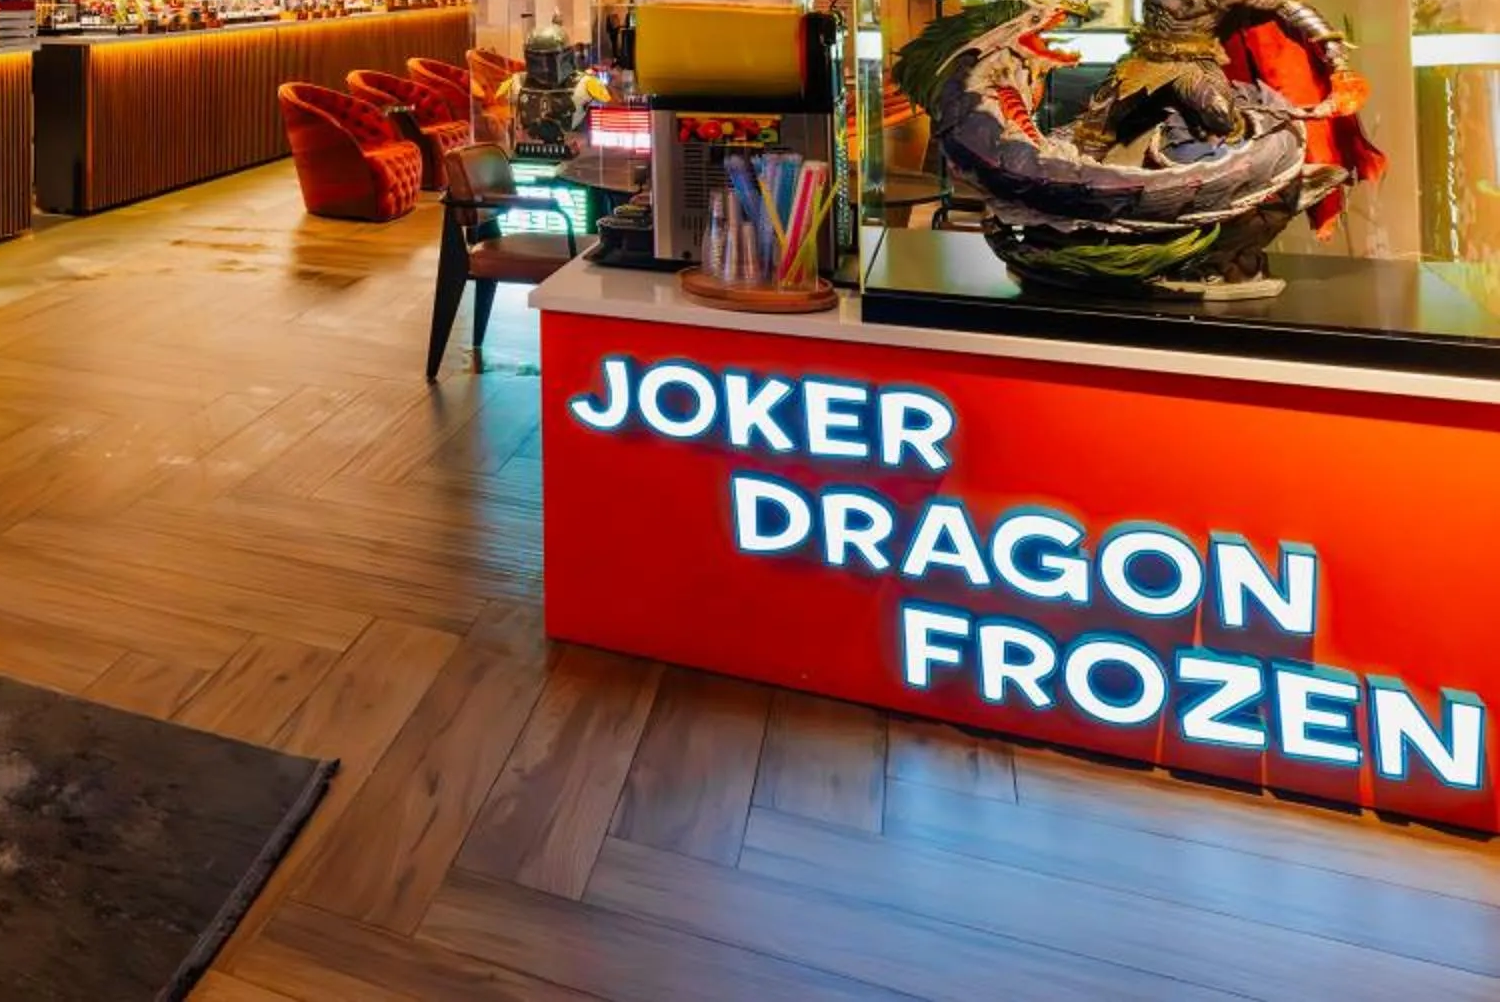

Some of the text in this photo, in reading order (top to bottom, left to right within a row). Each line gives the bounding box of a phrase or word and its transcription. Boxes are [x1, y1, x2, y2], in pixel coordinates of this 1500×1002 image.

[569, 359, 954, 470] JOKER
[733, 472, 1316, 634] DRAGON
[901, 604, 1486, 789] FROZEN
